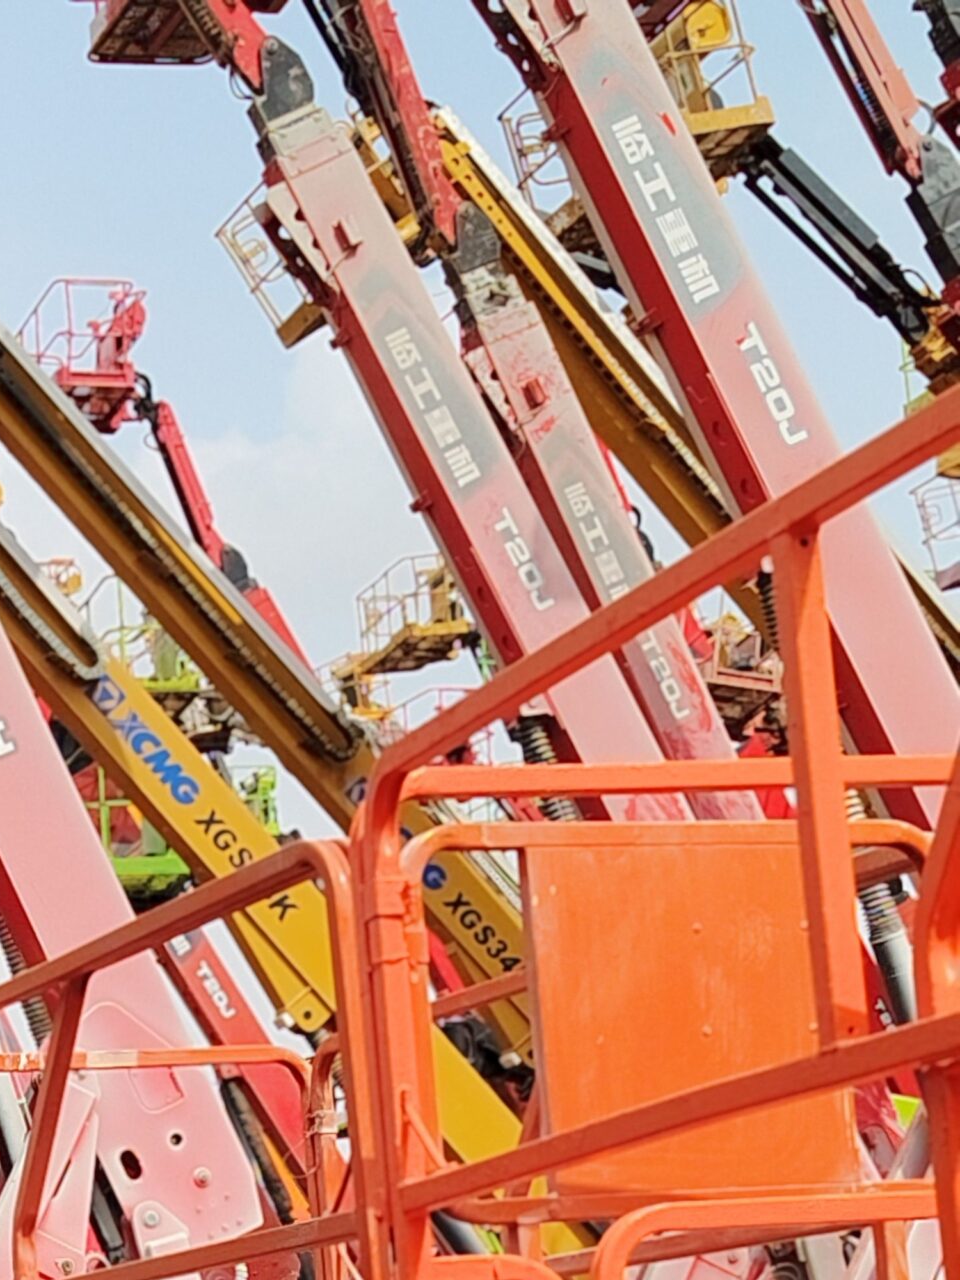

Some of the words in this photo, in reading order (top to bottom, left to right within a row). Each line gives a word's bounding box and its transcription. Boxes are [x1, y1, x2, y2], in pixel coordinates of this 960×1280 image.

[611, 115, 720, 304] 临工重机
[740, 322, 808, 445] T20J
[494, 507, 555, 611] T20J
[112, 711, 200, 805] XCMG
[195, 810, 298, 921] XGSK
